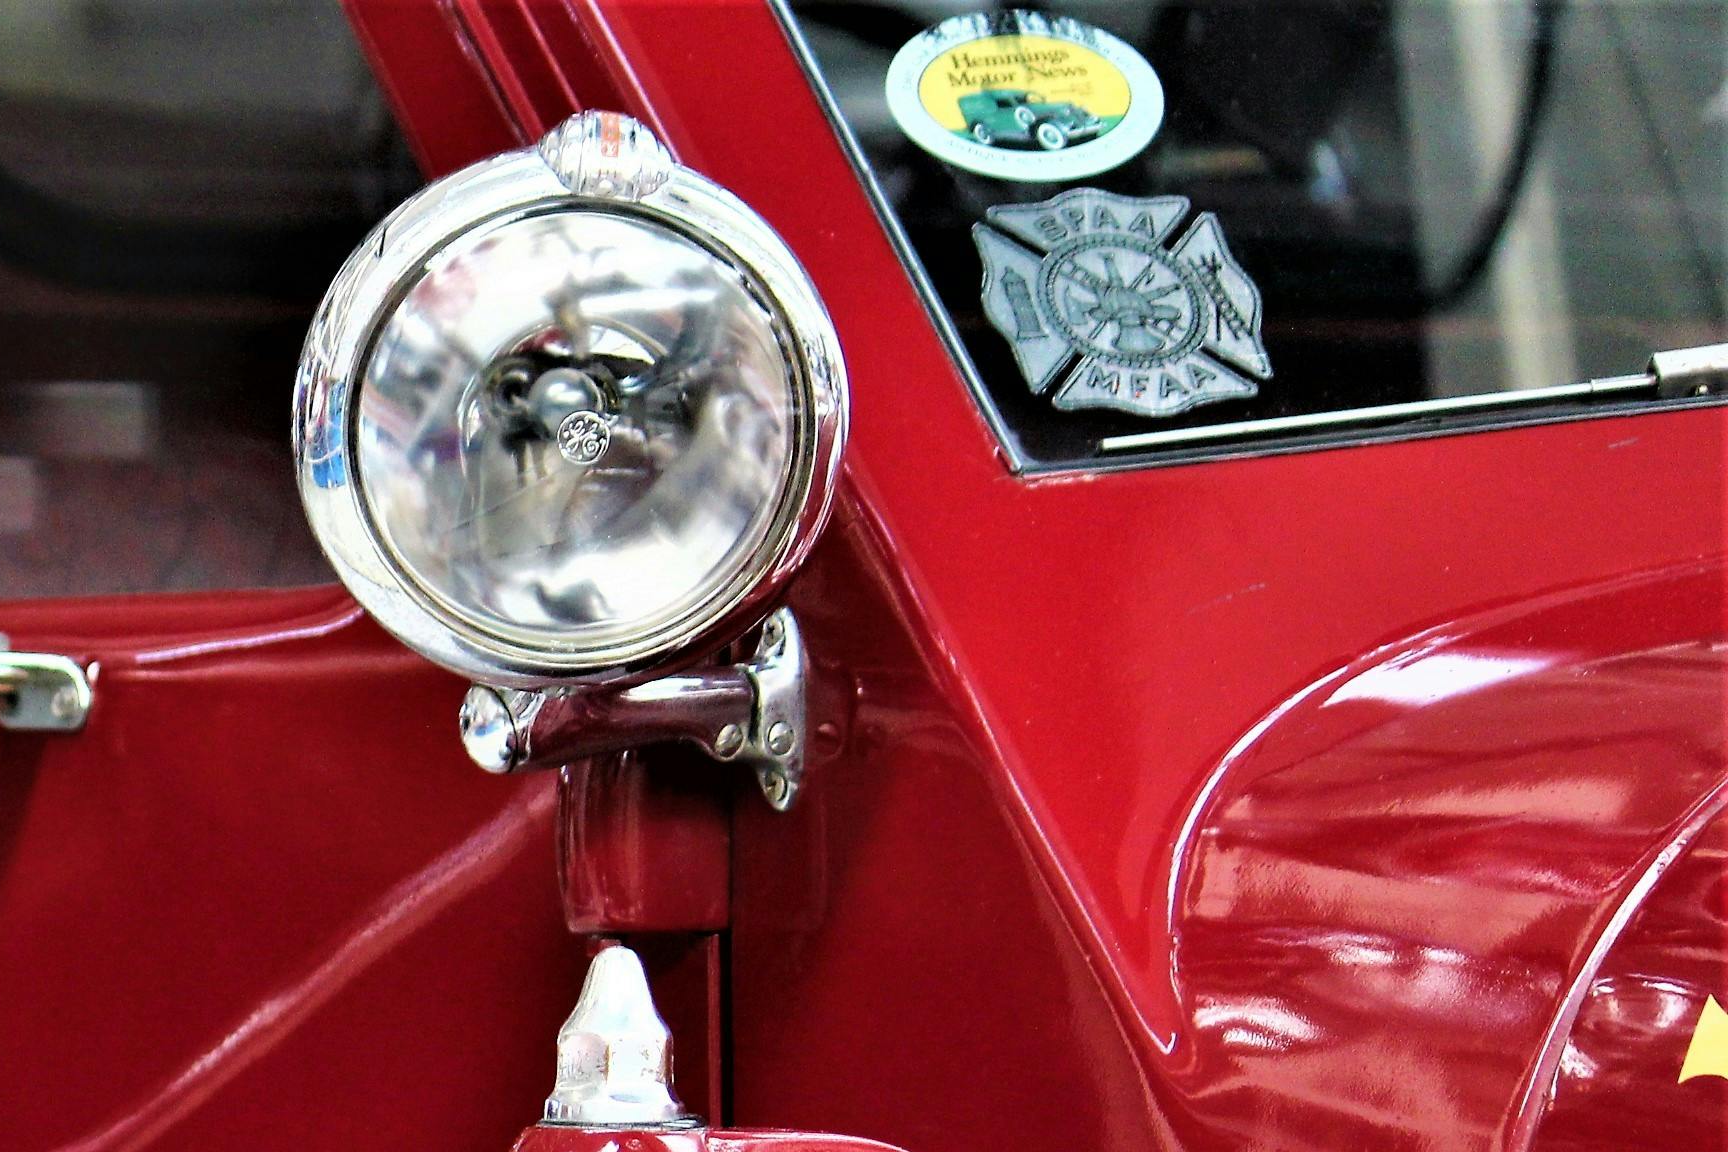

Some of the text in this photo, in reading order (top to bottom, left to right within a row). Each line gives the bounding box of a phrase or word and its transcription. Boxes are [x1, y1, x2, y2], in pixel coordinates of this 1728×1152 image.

[951, 50, 1070, 69] Hemmings
[947, 64, 1088, 87] Motor News
[1087, 362, 1217, 399] MFAA
